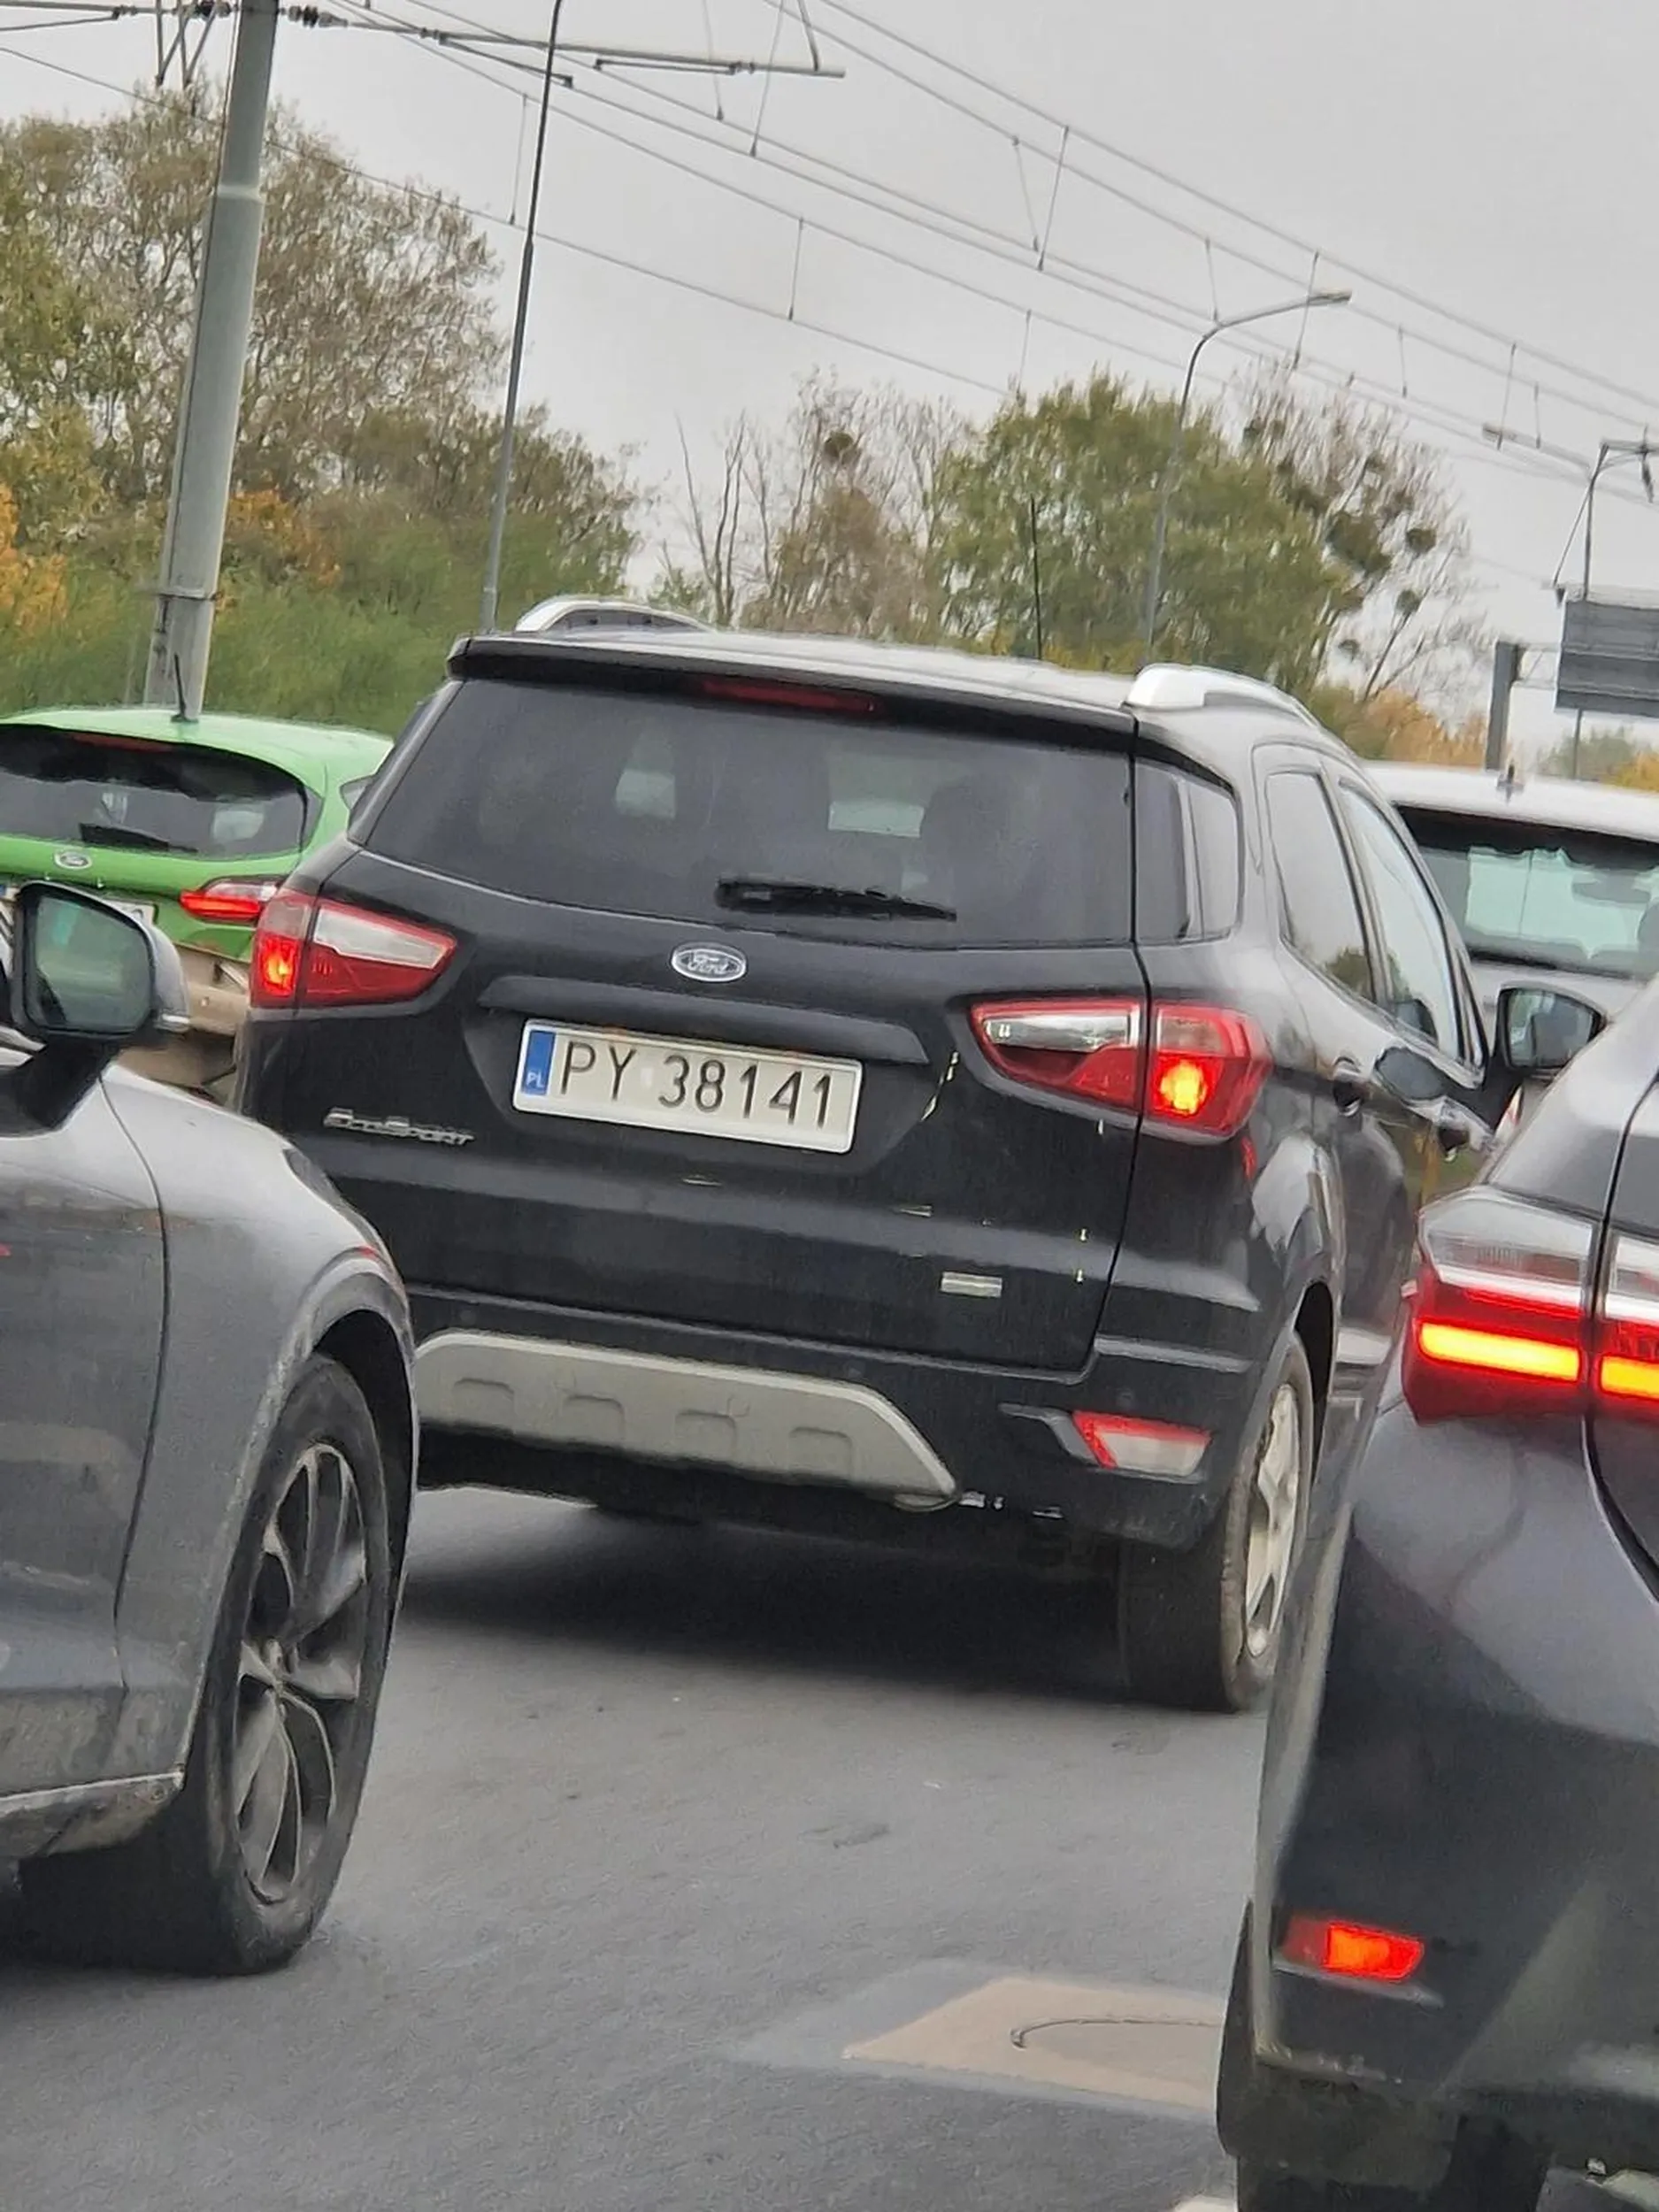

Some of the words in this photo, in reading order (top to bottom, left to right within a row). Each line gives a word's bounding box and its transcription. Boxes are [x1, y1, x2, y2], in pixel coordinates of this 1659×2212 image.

[526, 1071, 545, 1089] PL
[560, 1040, 637, 1102] PY
[657, 1055, 833, 1131] 38141
